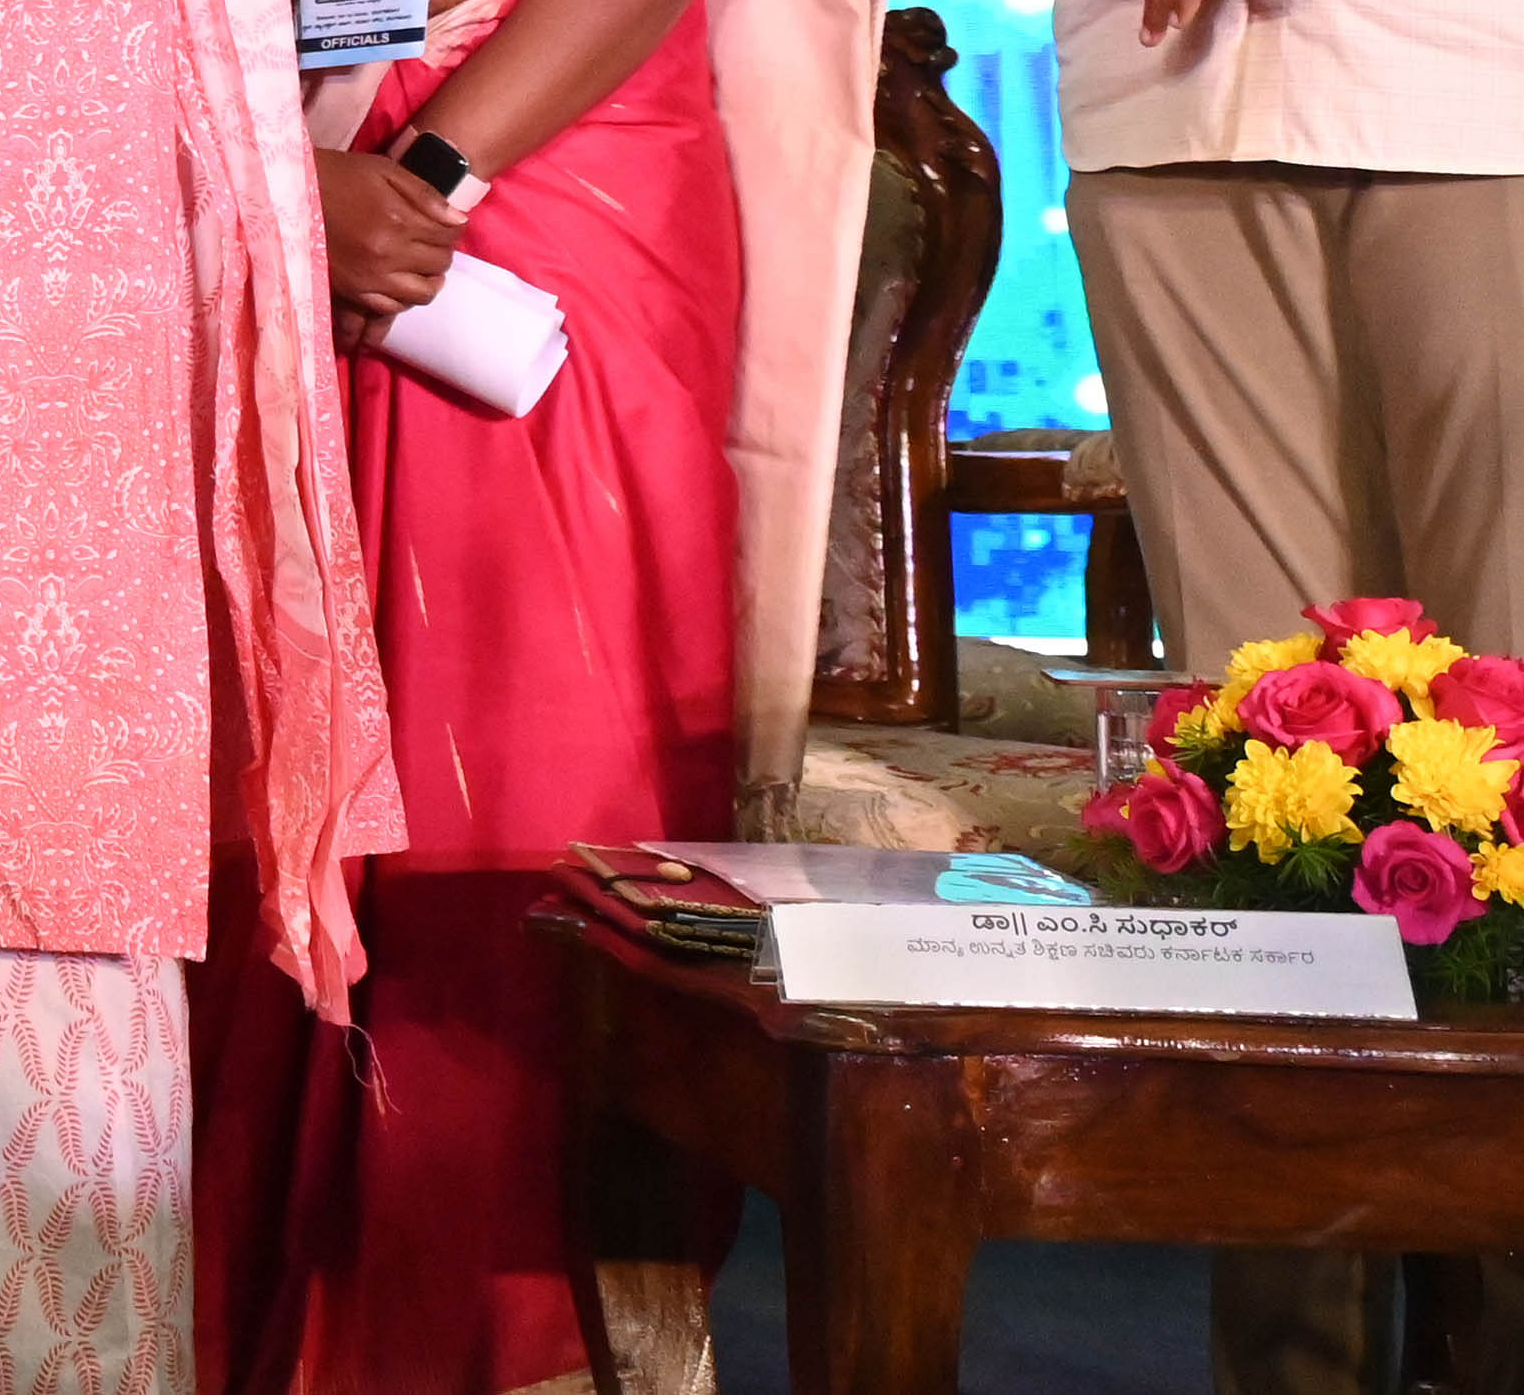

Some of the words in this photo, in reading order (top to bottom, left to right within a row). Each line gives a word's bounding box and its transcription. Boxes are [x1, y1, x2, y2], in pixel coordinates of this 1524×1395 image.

[321, 32, 390, 50] OFFICIALS
[1036, 912, 1108, 934] ಎಂ.ಸಿ
[1115, 914, 1238, 940] ಸುಧಾಕರ್
[906, 937, 964, 957] ಮಾನ್ಯ
[969, 939, 1027, 958] ಉನ್ನತ
[1032, 938, 1078, 961] ಶಿಕ್ಷಣ
[1084, 943, 1155, 960] ಸಚಿವರು
[1160, 945, 1244, 963] ಕರ್ನಾಟಕ
[1250, 948, 1315, 965] ಸರ್ಕಾರ
